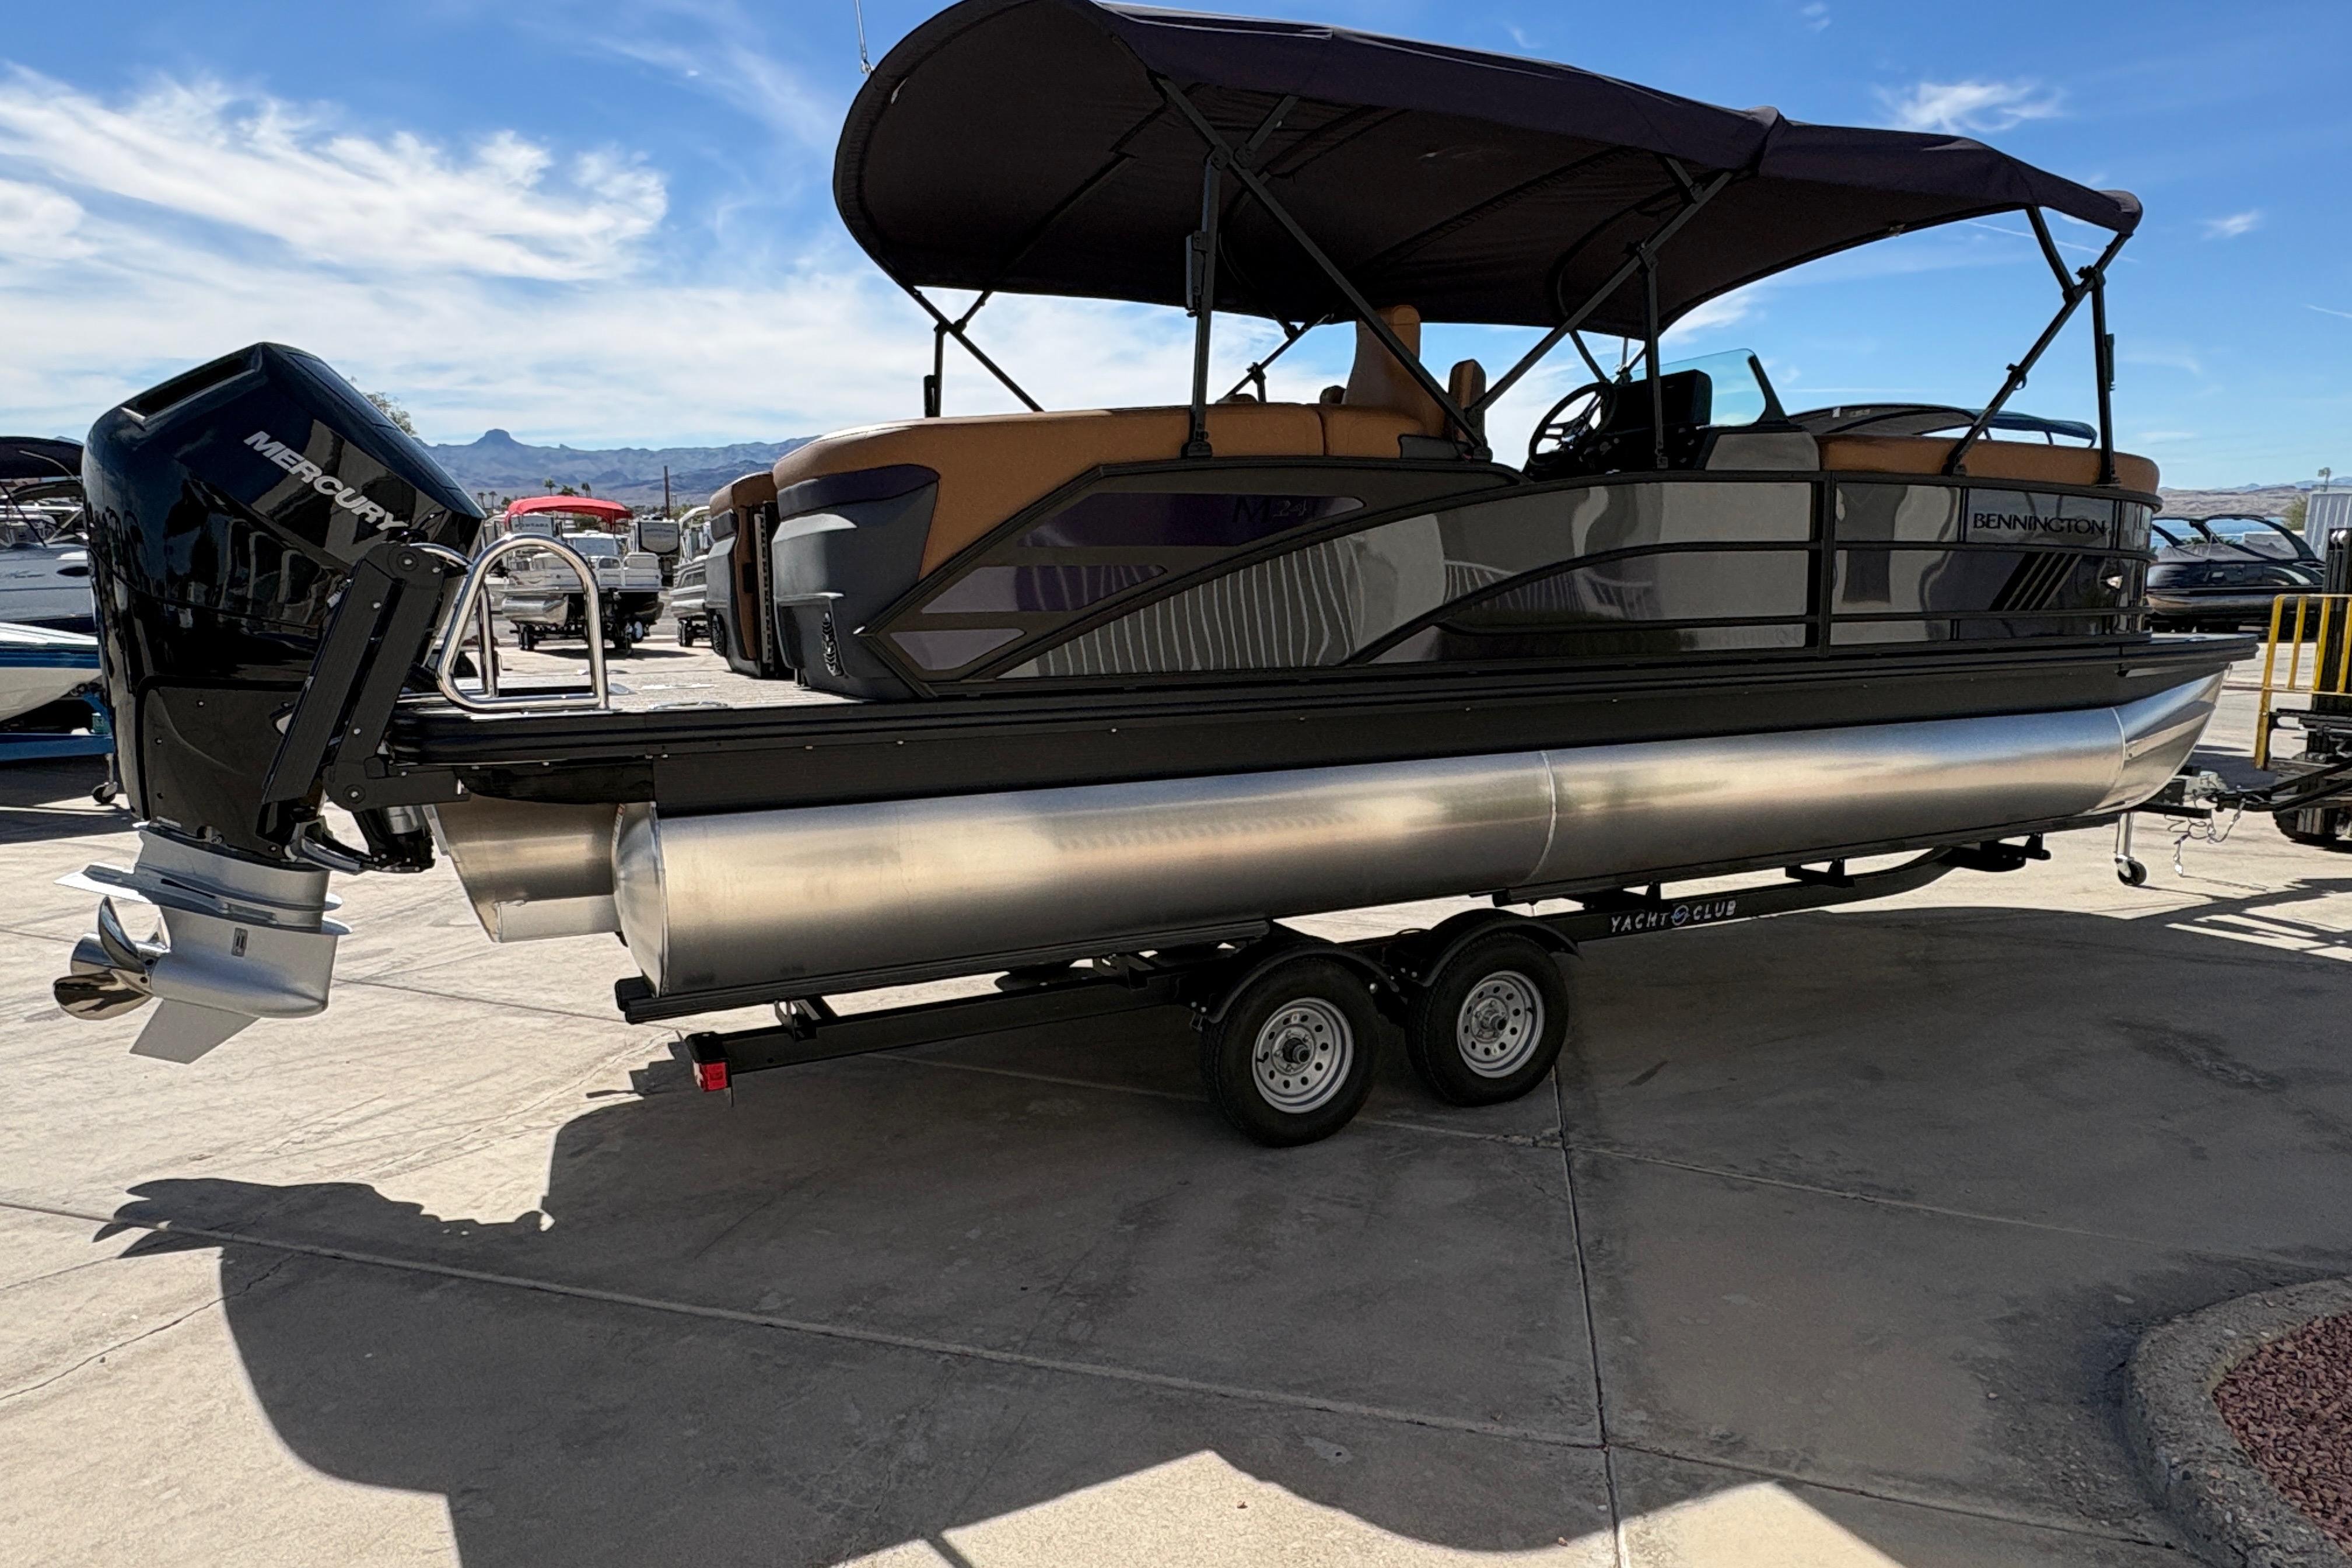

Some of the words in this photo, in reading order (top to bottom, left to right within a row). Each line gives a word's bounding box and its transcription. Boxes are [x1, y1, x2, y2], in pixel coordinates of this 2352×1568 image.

[243, 430, 409, 531] MERCURY
[1973, 513, 2108, 535] BENNINGTON
[1611, 911, 1671, 933] YACHT
[1693, 900, 1737, 921] CLUB
